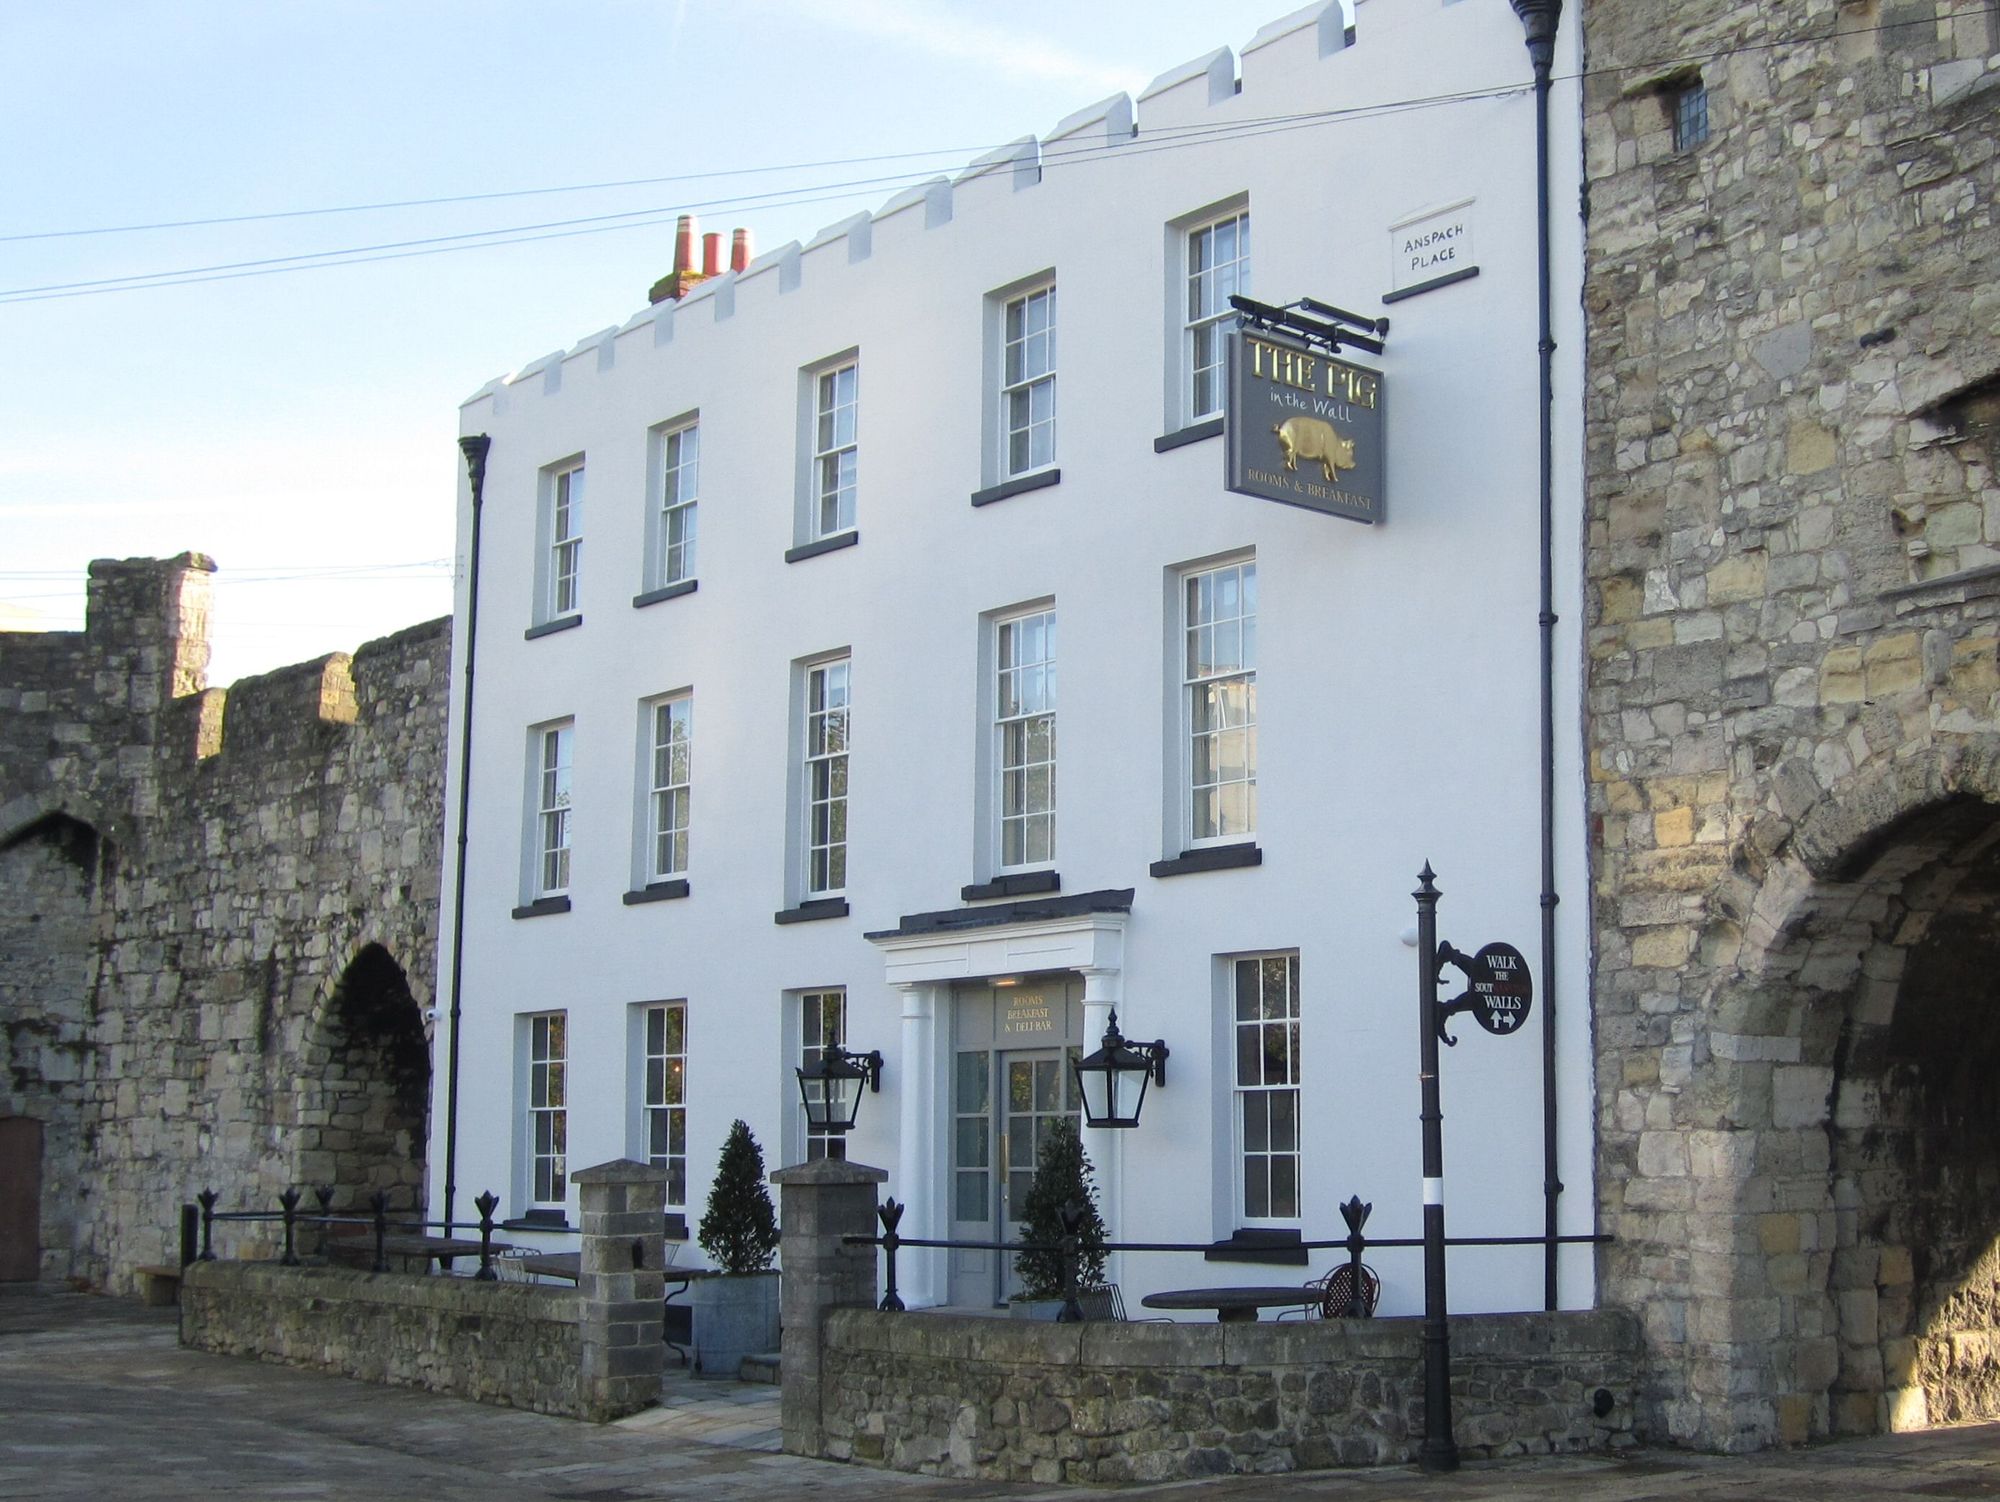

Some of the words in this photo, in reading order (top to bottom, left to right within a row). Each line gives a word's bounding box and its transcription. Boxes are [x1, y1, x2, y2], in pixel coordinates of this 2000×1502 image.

[1404, 224, 1464, 253] ANSPACH
[1411, 247, 1456, 271] PLACE
[1246, 337, 1316, 392] THE
[1326, 361, 1377, 410] PIG
[1270, 386, 1283, 407] in
[1284, 392, 1307, 410] the
[1313, 397, 1353, 423] Wall
[1248, 468, 1290, 489] ROOMS
[1294, 480, 1304, 494] &
[1308, 482, 1373, 511] BREAKFAST
[1486, 955, 1518, 970] WALK
[1494, 971, 1509, 981] THE
[1013, 995, 1044, 1007] ROOMS
[1484, 995, 1522, 1010] WALLS
[1007, 1007, 1049, 1020] BREAKFAST
